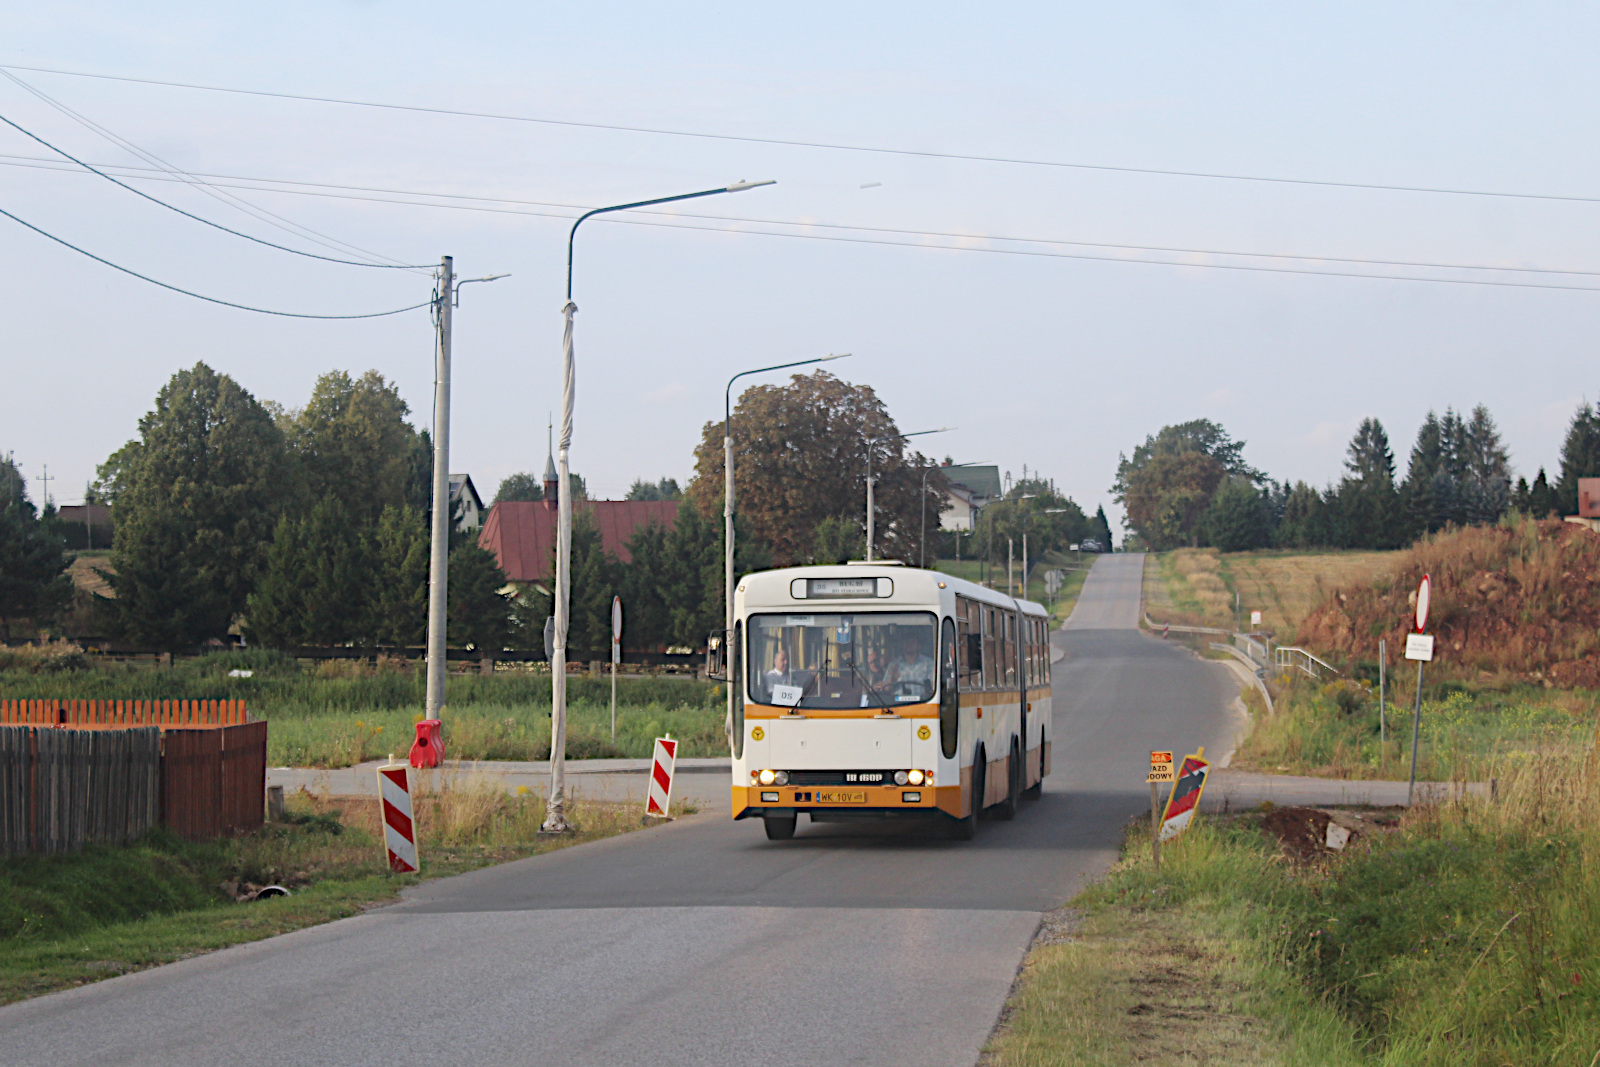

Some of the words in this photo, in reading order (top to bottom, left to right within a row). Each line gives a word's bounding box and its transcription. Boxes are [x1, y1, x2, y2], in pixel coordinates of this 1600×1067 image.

[781, 691, 793, 700] DS
[859, 773, 883, 782] 160P
[821, 793, 834, 802] WK
[837, 793, 852, 802] 10V
